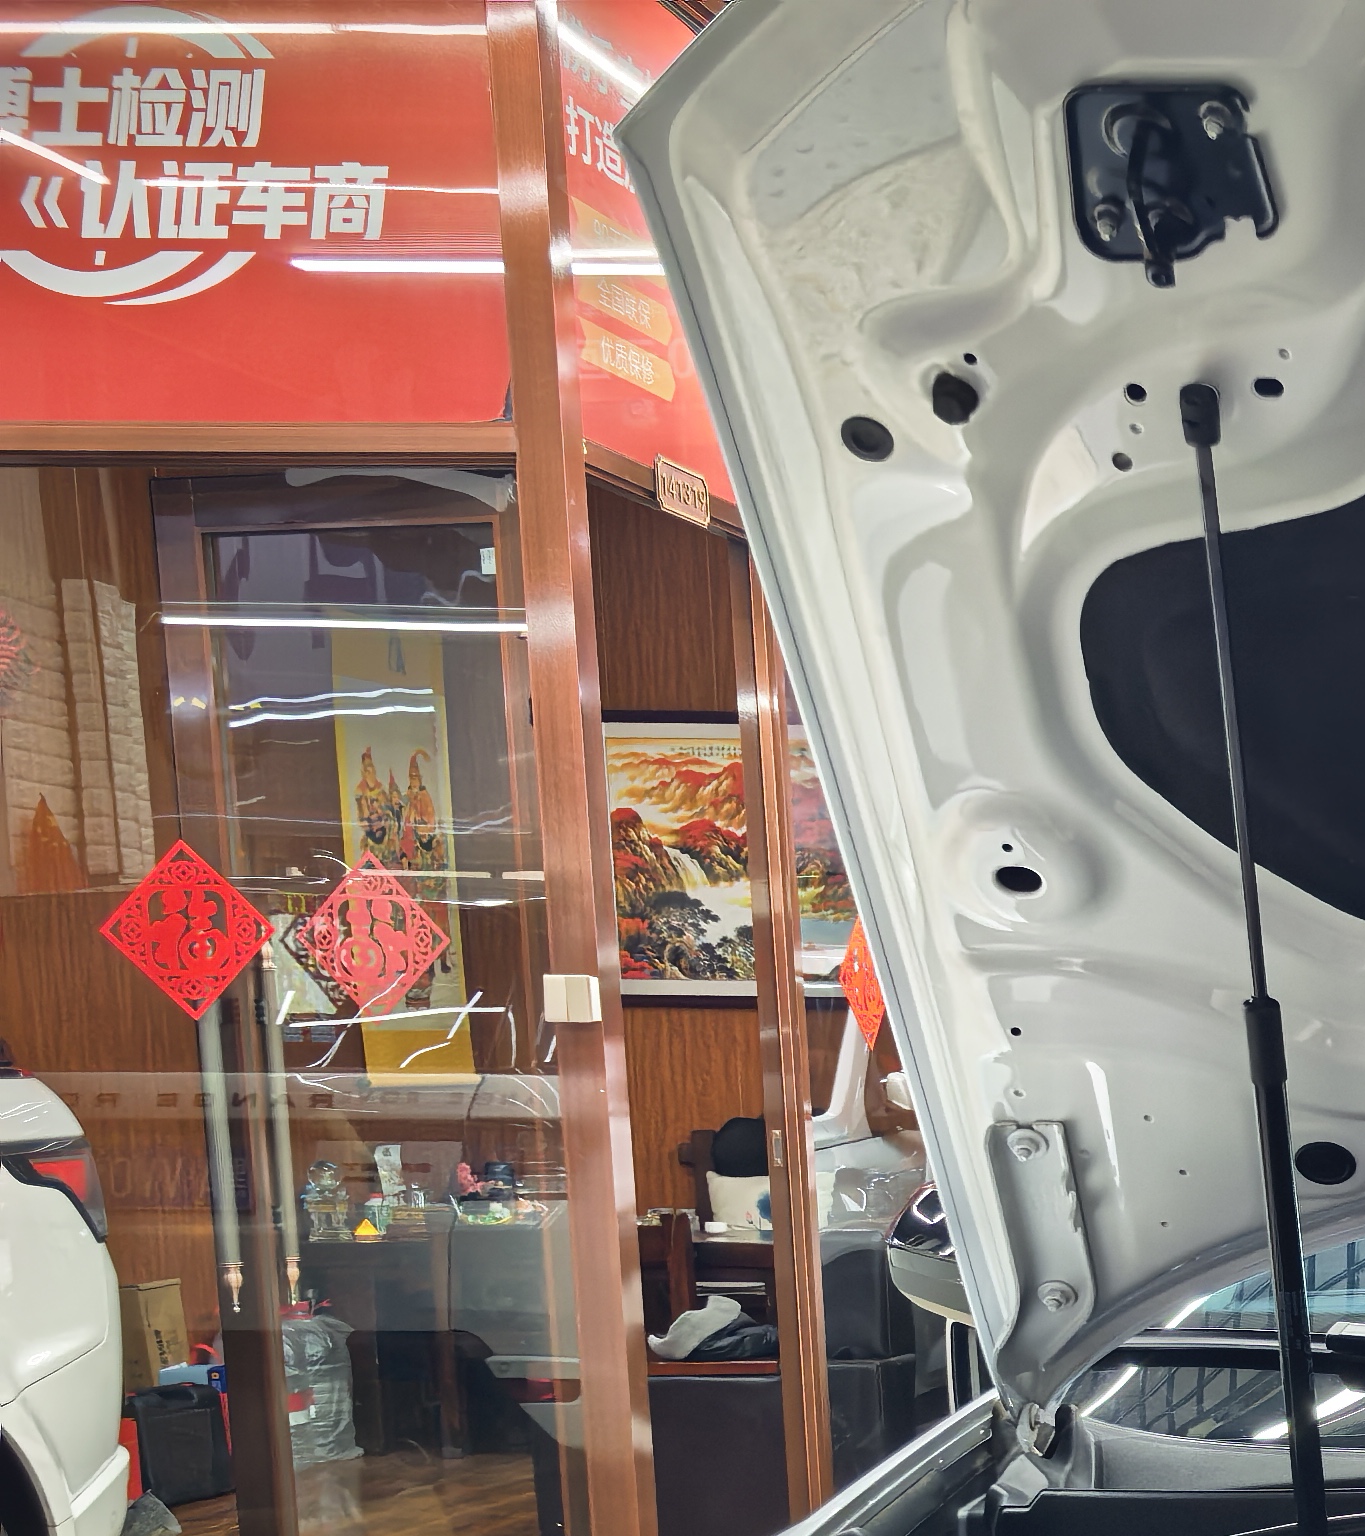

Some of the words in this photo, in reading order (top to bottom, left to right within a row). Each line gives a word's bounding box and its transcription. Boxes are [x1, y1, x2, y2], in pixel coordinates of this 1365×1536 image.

[80, 159, 390, 240] 认证车商
[601, 335, 655, 385] 优质保修
